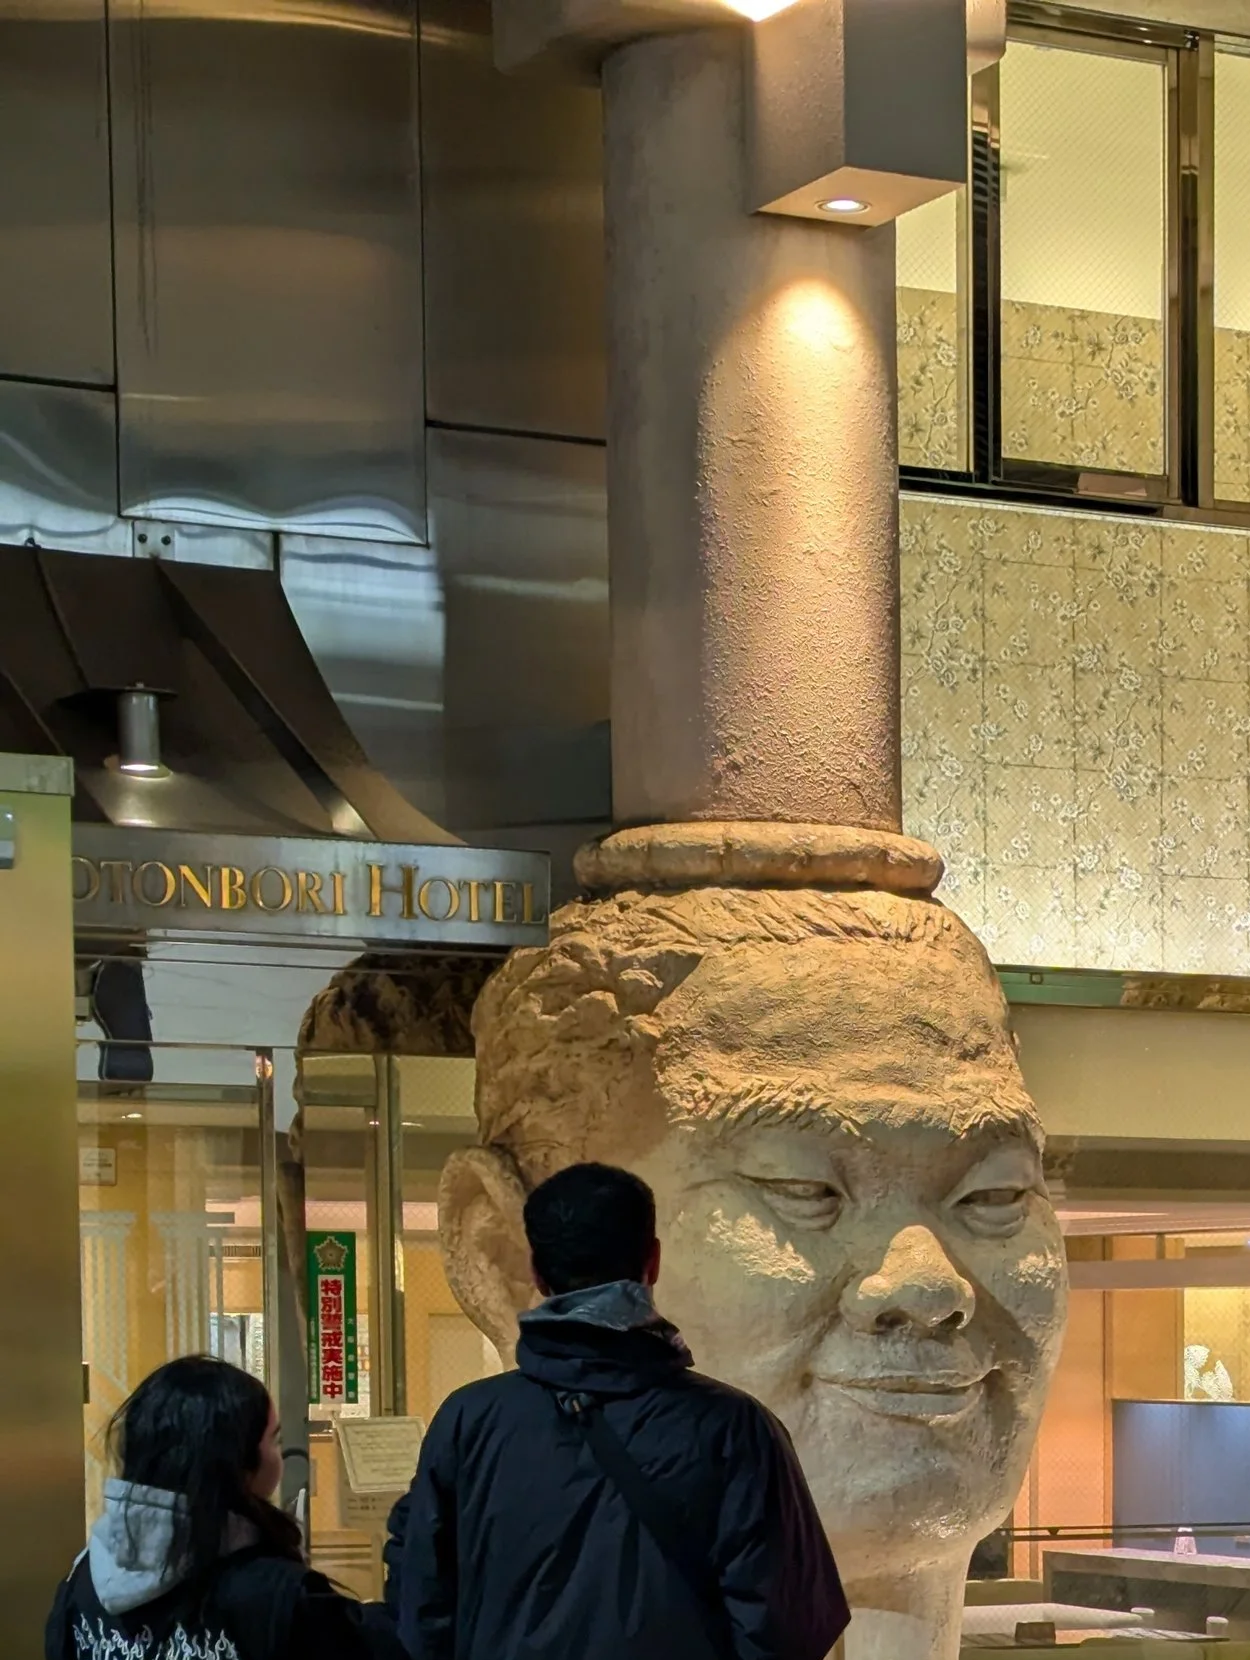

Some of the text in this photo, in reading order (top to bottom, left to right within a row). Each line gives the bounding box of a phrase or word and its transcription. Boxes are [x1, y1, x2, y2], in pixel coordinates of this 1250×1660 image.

[72, 856, 546, 925] OTONBORI HOTEL
[321, 1279, 343, 1399] 特別警戒実施中
